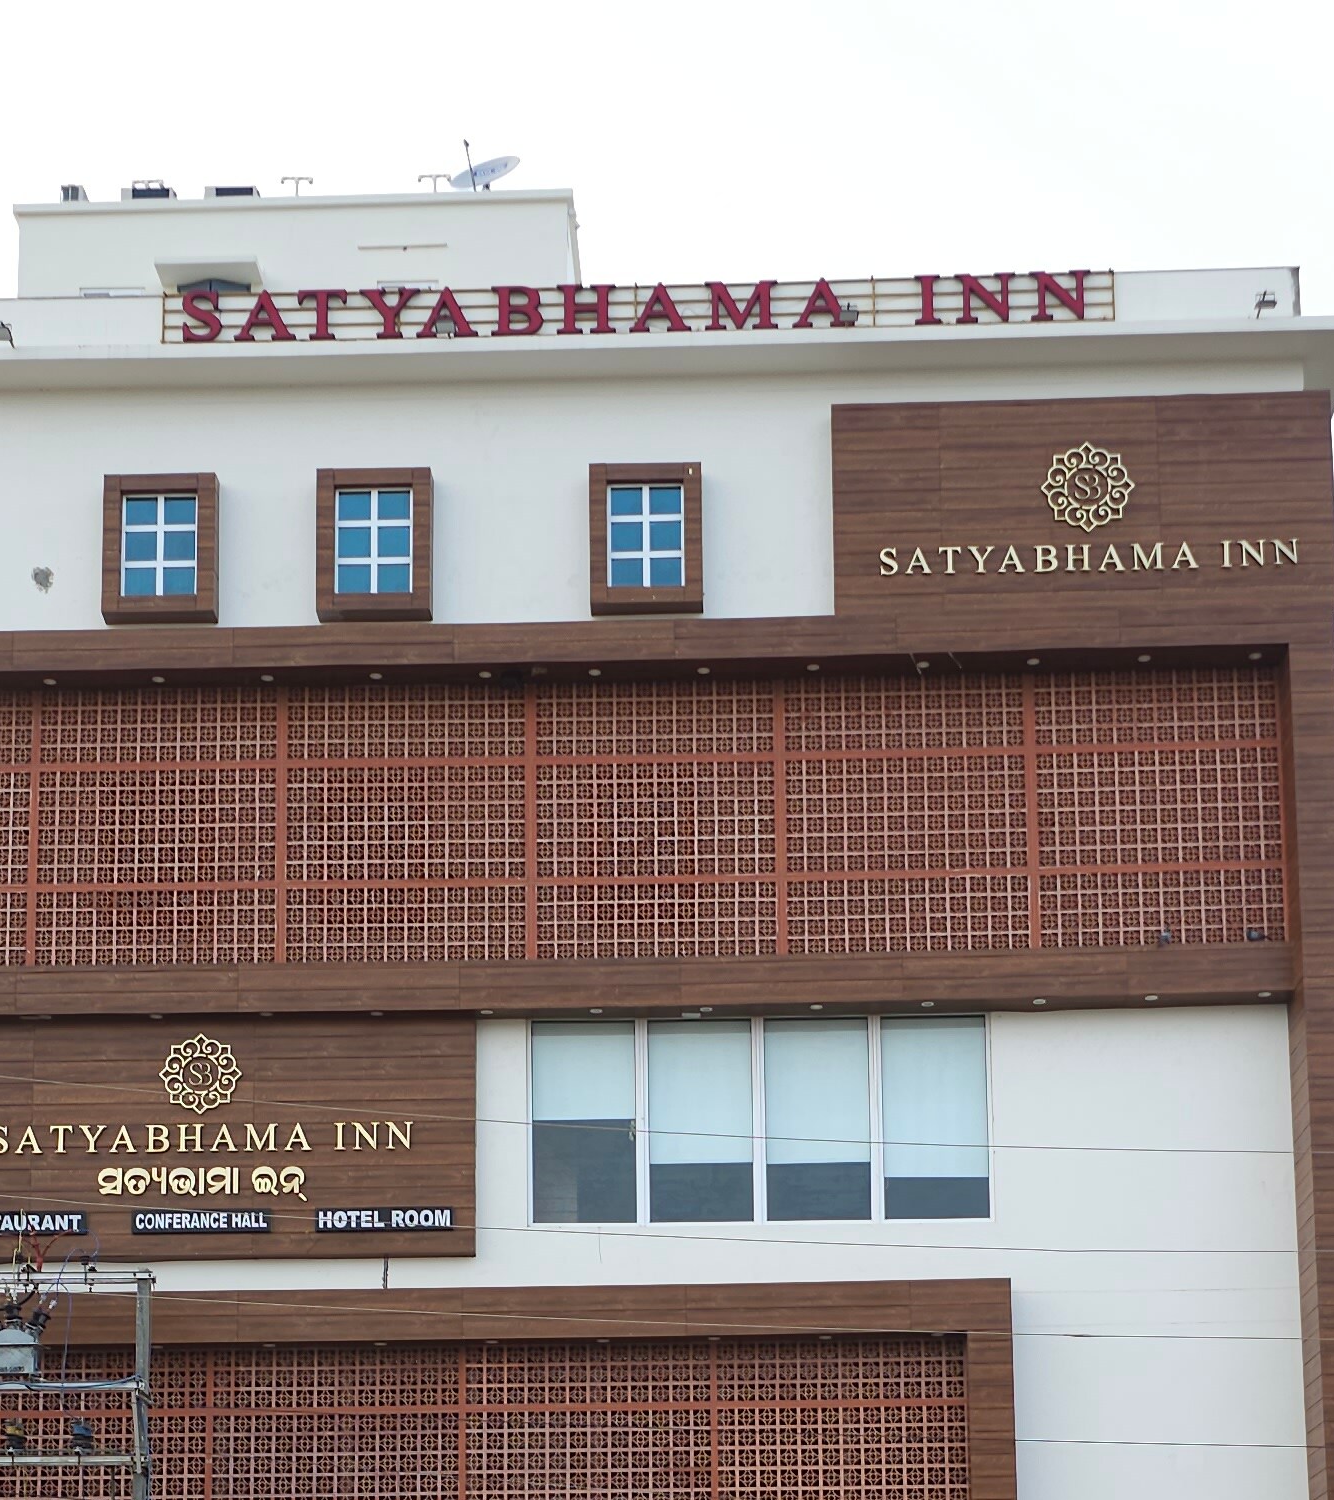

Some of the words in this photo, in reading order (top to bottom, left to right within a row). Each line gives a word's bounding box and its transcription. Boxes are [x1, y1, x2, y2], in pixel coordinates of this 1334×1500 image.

[181, 277, 858, 343] SATYABHAMA
[914, 270, 1091, 326] INN
[879, 541, 1199, 577] SATYABHAMA
[1221, 538, 1300, 569] INN
[334, 1121, 415, 1151] INN
[97, 1166, 240, 1197] ସତ୍ୟଭାମା
[135, 1212, 229, 1231] CONFERANCE
[230, 1211, 268, 1229] HALL
[317, 1210, 386, 1229] HOTEL
[390, 1209, 452, 1228] ROOM
